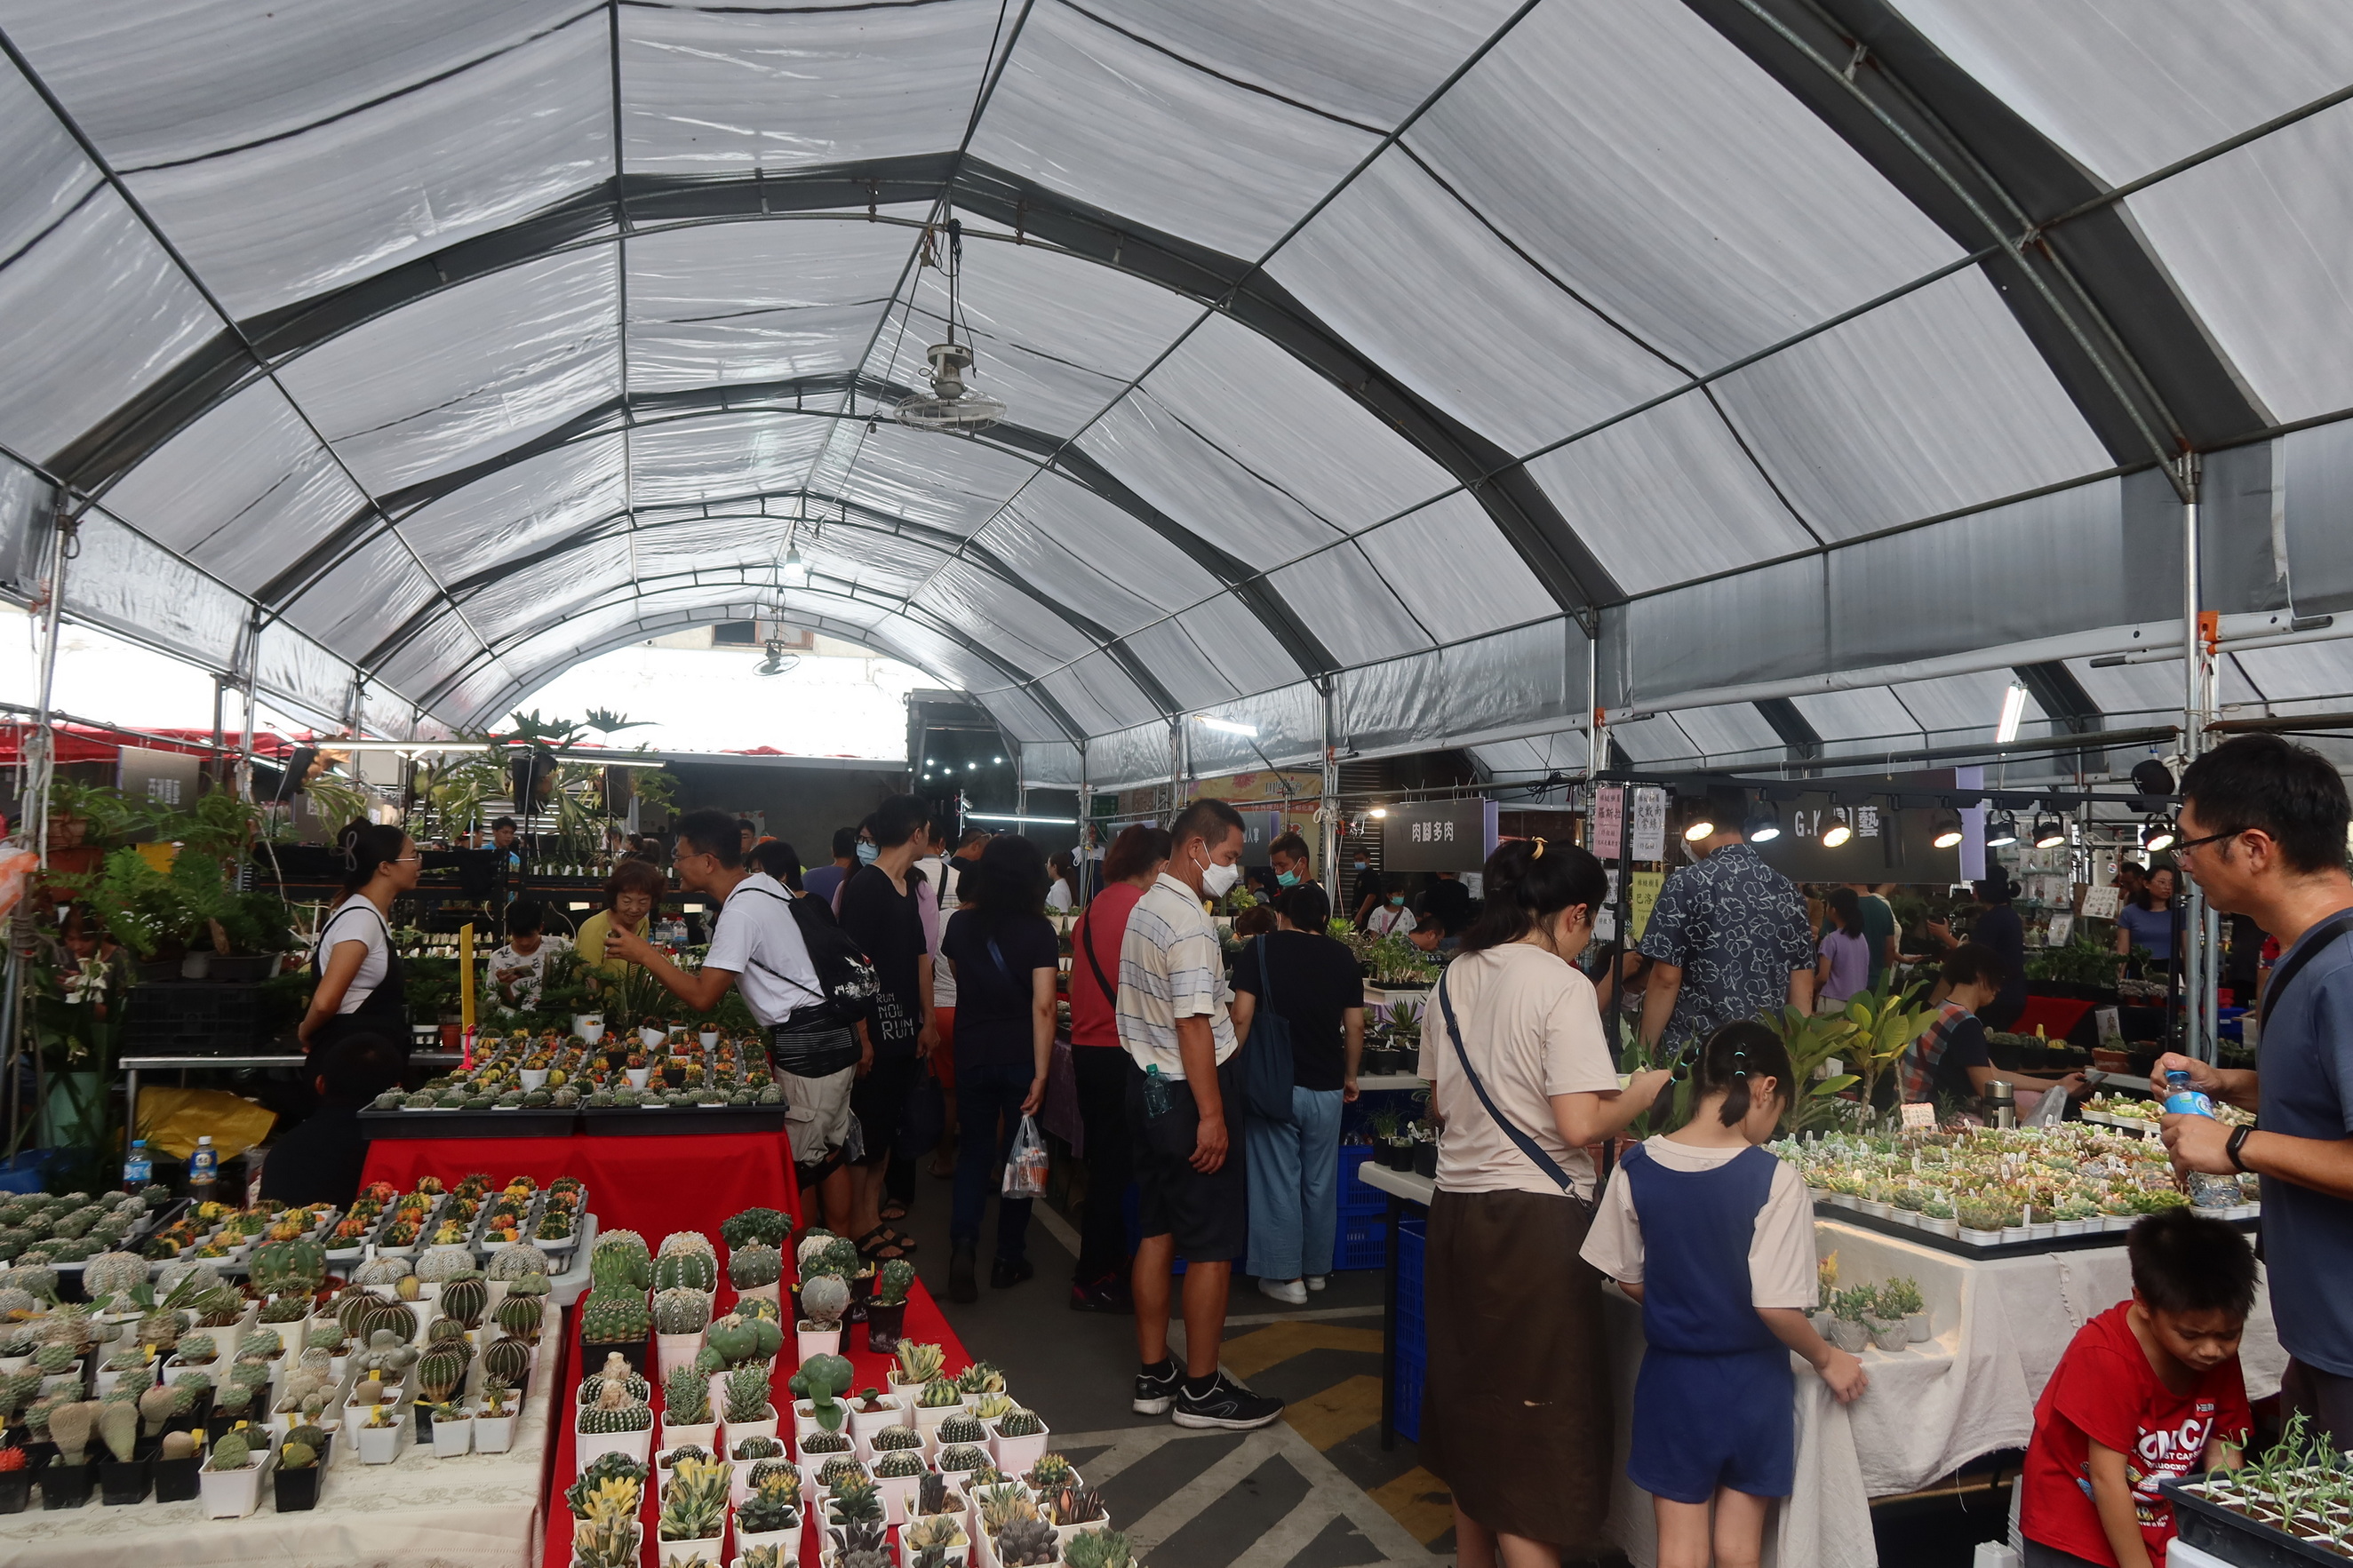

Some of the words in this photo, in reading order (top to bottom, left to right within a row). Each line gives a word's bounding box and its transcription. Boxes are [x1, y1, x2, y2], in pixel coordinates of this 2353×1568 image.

[1412, 820, 1454, 843] 肉腳多肉
[876, 992, 895, 1004] RUN
[881, 1017, 914, 1040] RUN
